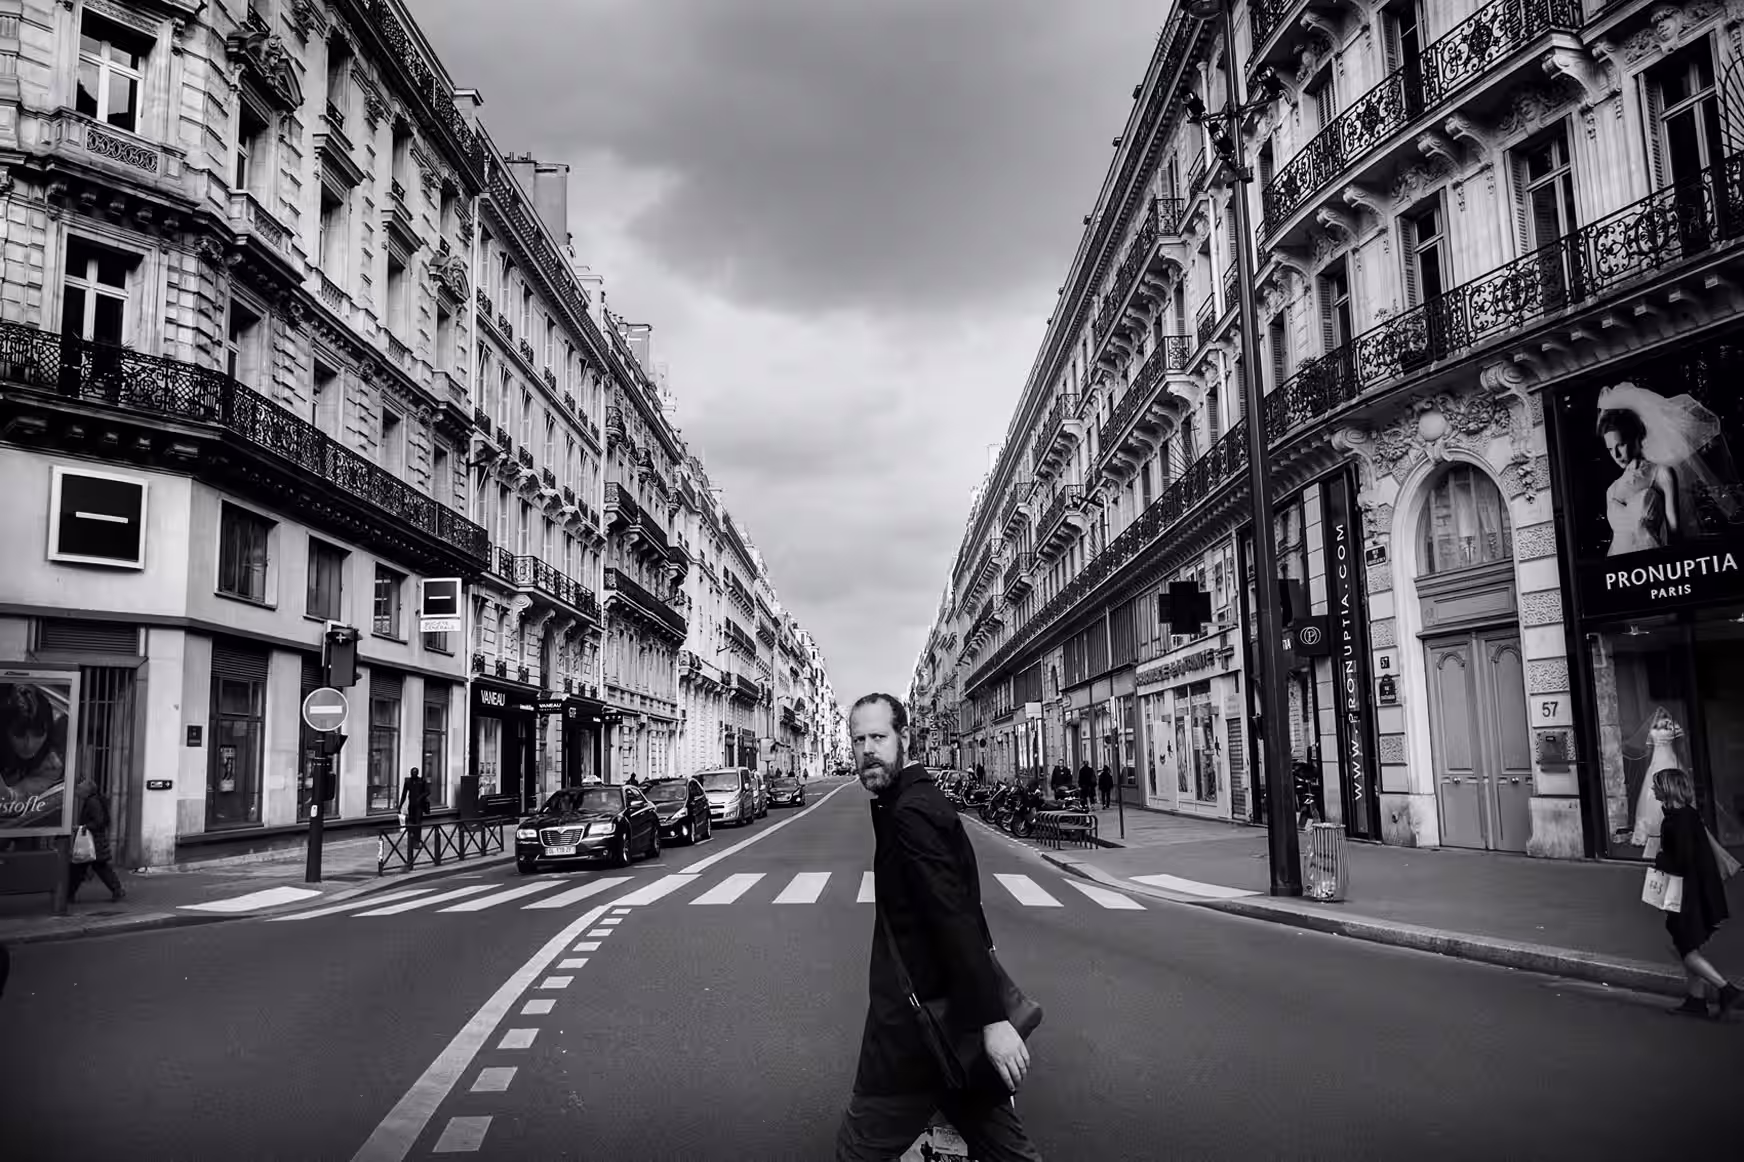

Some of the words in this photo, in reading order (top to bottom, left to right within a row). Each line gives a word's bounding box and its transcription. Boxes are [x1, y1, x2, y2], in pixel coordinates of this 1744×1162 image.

[1605, 553, 1738, 590] PRONUPTIA
[1651, 584, 1692, 599] PARIS
[1336, 524, 1362, 800] WWW.PRONUPTIA.COM
[481, 689, 506, 706] VANEAU
[1542, 701, 1558, 717] 57
